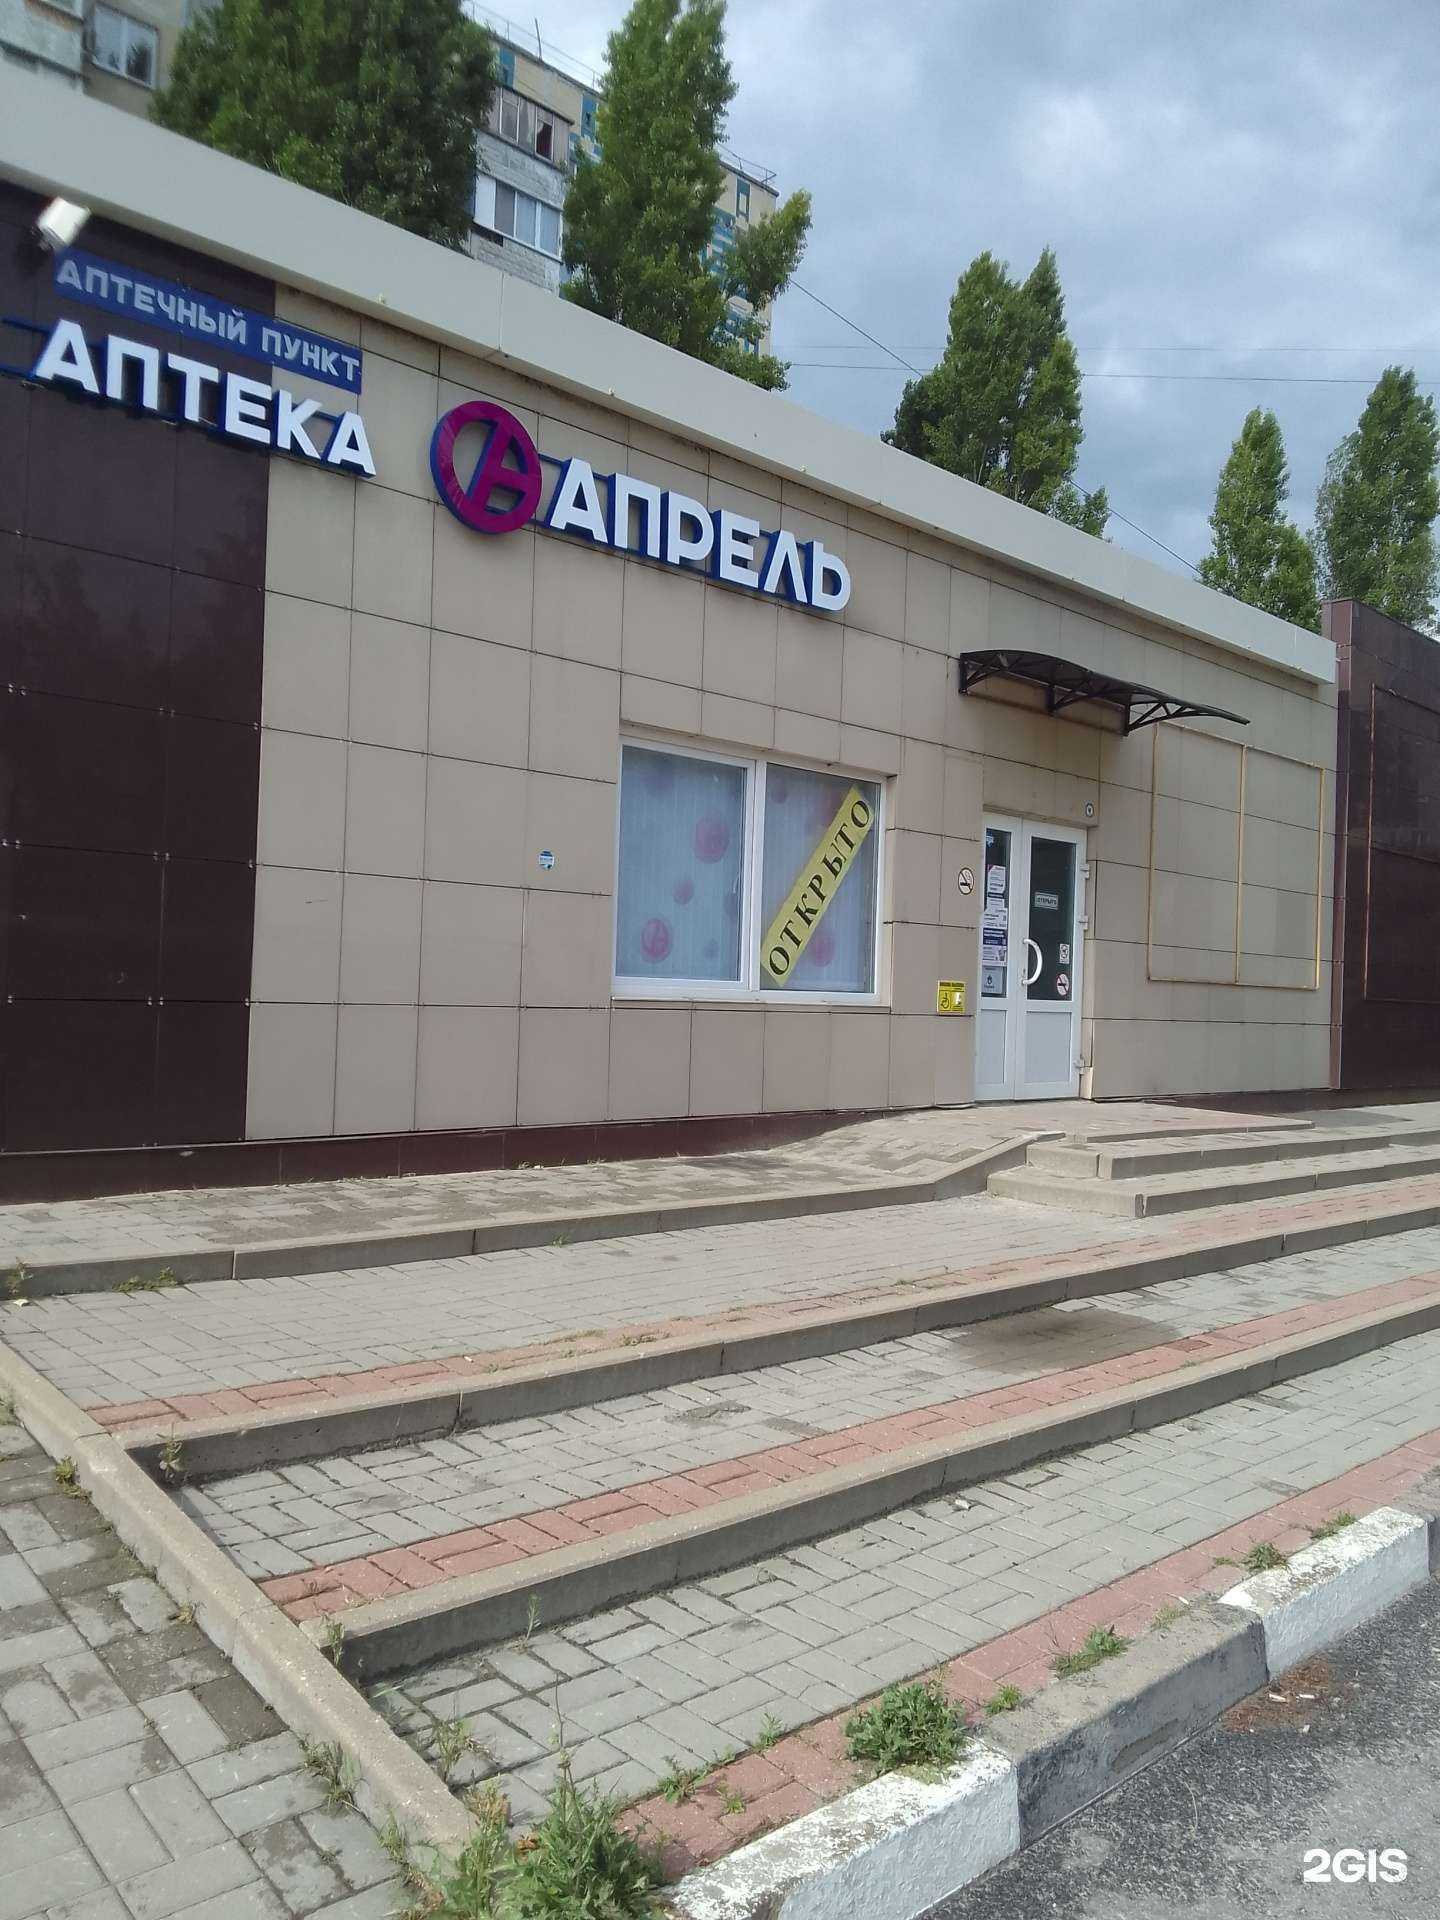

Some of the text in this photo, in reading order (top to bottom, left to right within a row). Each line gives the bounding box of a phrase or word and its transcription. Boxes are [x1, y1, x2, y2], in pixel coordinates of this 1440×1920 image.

[35, 318, 376, 477] АПТЕКА
[57, 258, 360, 382] АПТЕЧНЫЙ ПУНКТ
[549, 457, 851, 611] АПРЕЛЬ
[769, 800, 870, 976] ОТКРЫТО
